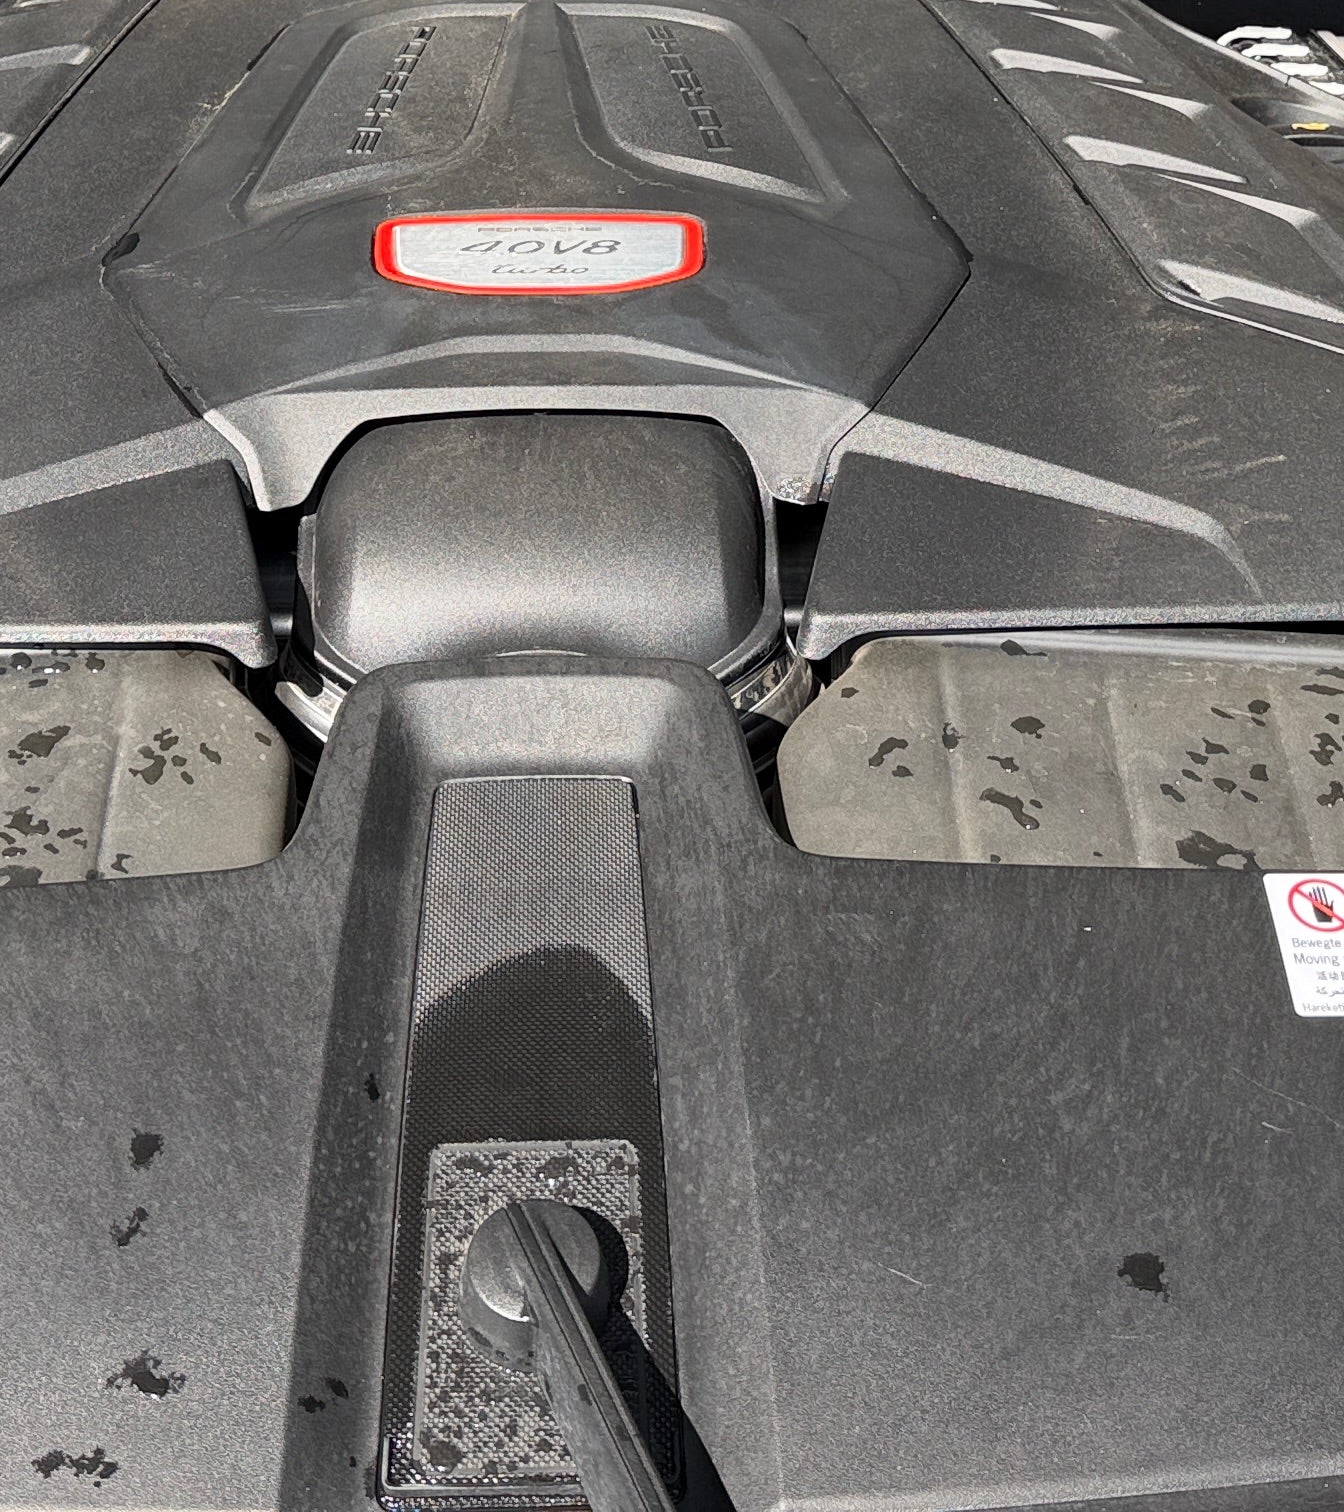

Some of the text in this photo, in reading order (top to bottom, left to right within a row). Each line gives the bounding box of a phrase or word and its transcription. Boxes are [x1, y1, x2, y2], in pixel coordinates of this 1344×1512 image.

[345, 26, 437, 154] PORSCHE
[644, 25, 734, 153] PORSCHE
[491, 263, 590, 275] turbo
[1291, 937, 1342, 949] Bewegte
[1293, 952, 1341, 967] Moving
